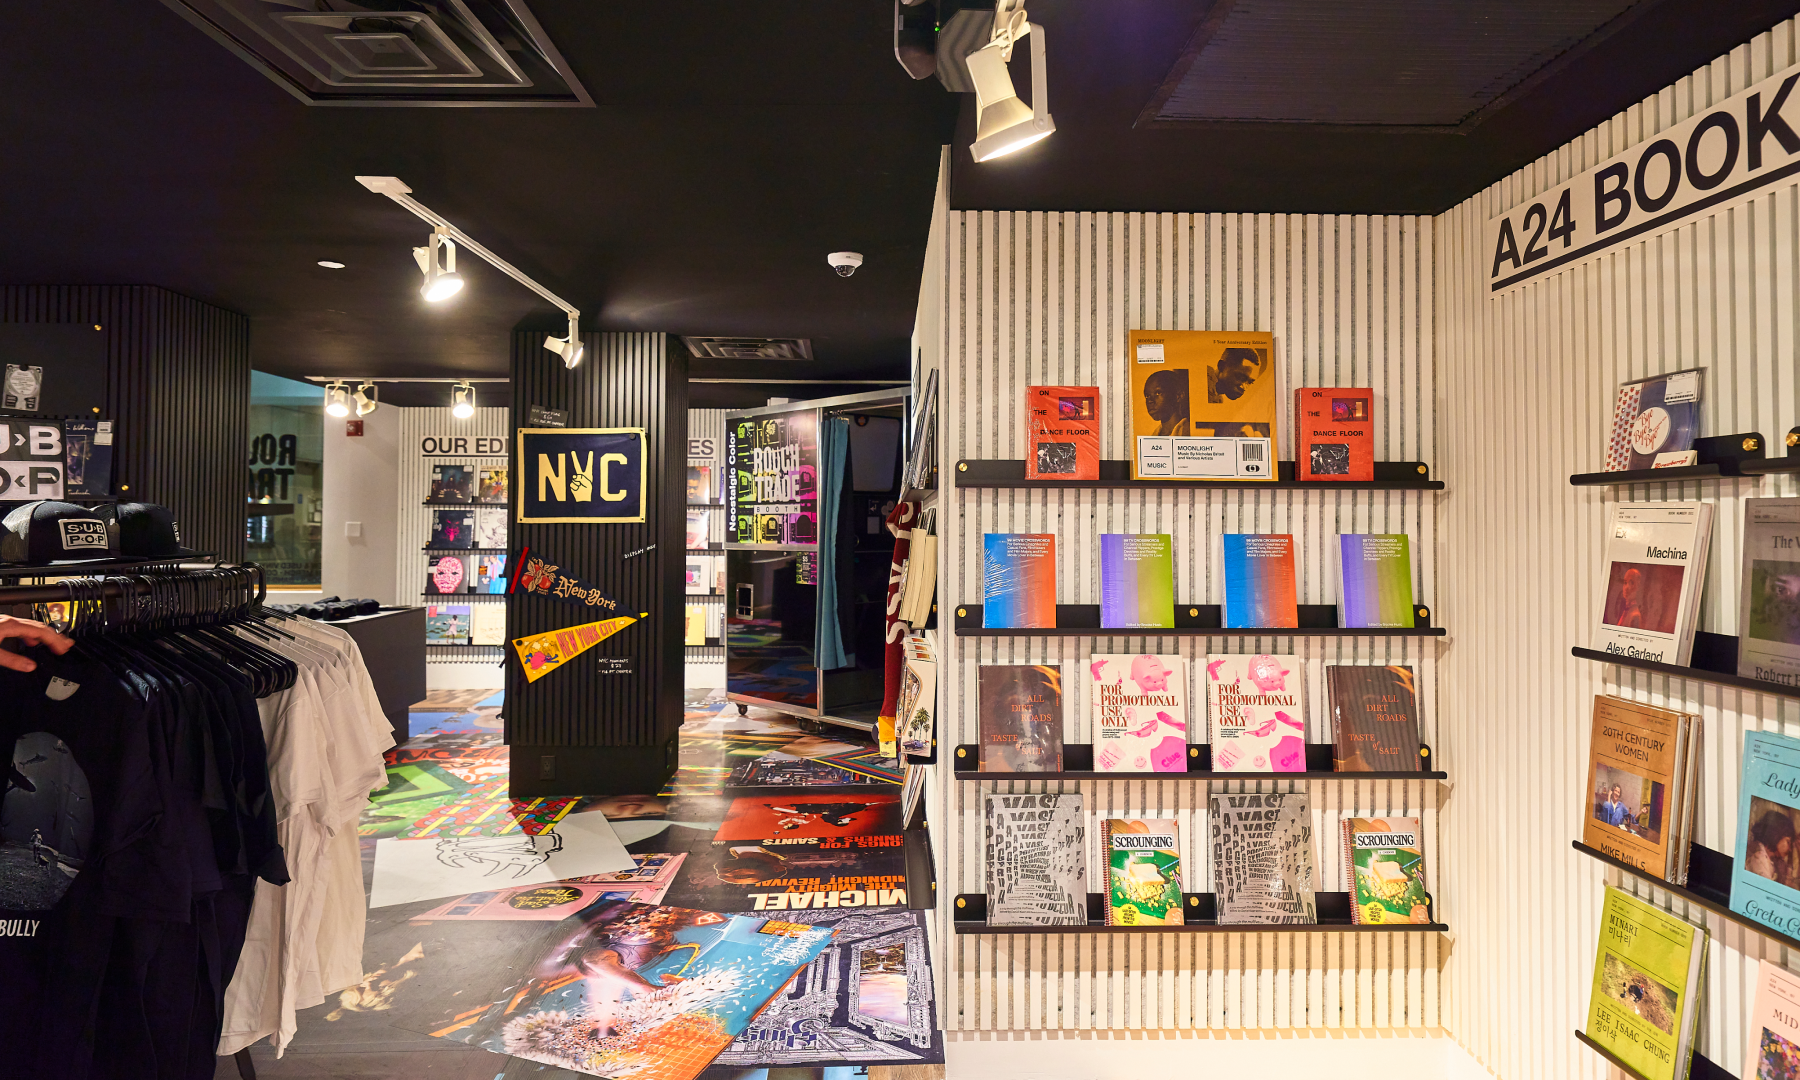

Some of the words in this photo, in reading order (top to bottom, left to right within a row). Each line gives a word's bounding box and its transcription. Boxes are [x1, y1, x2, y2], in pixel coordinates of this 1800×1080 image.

[1491, 187, 1577, 279] A24
[422, 437, 468, 454] OUR
[753, 444, 800, 474] ROUGH
[754, 474, 801, 504] TRADE
[729, 467, 737, 532] Neostalgic
[1615, 527, 1626, 538] Ex
[1772, 535, 1793, 548] The
[1646, 546, 1687, 560] Machina
[552, 576, 587, 599] New
[585, 588, 616, 611] York
[556, 630, 579, 659] NEW
[575, 625, 601, 649] YORK
[599, 620, 617, 637] CITY
[1606, 642, 1626, 656] Alex
[1628, 646, 1664, 662] Garland
[1756, 666, 1792, 685] Robert
[1100, 685, 1123, 695] FOR
[1218, 684, 1241, 695] FOR
[1100, 695, 1178, 706] PROMOTIONAL
[1218, 695, 1296, 706] PROMOTIONAL
[1101, 706, 1122, 716] USE
[1220, 706, 1240, 716] USE
[1102, 717, 1129, 727] ONLY
[1220, 716, 1248, 726] ONLY
[1602, 726, 1623, 740] 20TH
[1625, 733, 1665, 752] CENTURY
[1161, 752, 1181, 767] Clue
[1281, 752, 1299, 767] Clue
[1615, 743, 1649, 762] WOMEN
[1761, 773, 1800, 799] Lady
[762, 837, 820, 846] SAINTS
[1115, 836, 1173, 848] SCROUNGING
[1358, 834, 1414, 846] SCROUNGING
[1600, 843, 1620, 859] MIKE
[1622, 853, 1646, 871] MILLS
[785, 883, 857, 893] MIGHTY
[748, 889, 907, 910] MICHAEL
[1742, 900, 1785, 927] Greta
[1610, 914, 1638, 937] MINARI
[1609, 926, 1631, 947] 미나리
[1596, 1019, 1617, 1042] 정이삭
[1597, 1008, 1611, 1023] LEE
[1615, 1020, 1639, 1042] ISAAC
[1644, 1040, 1670, 1064] CHUNG
